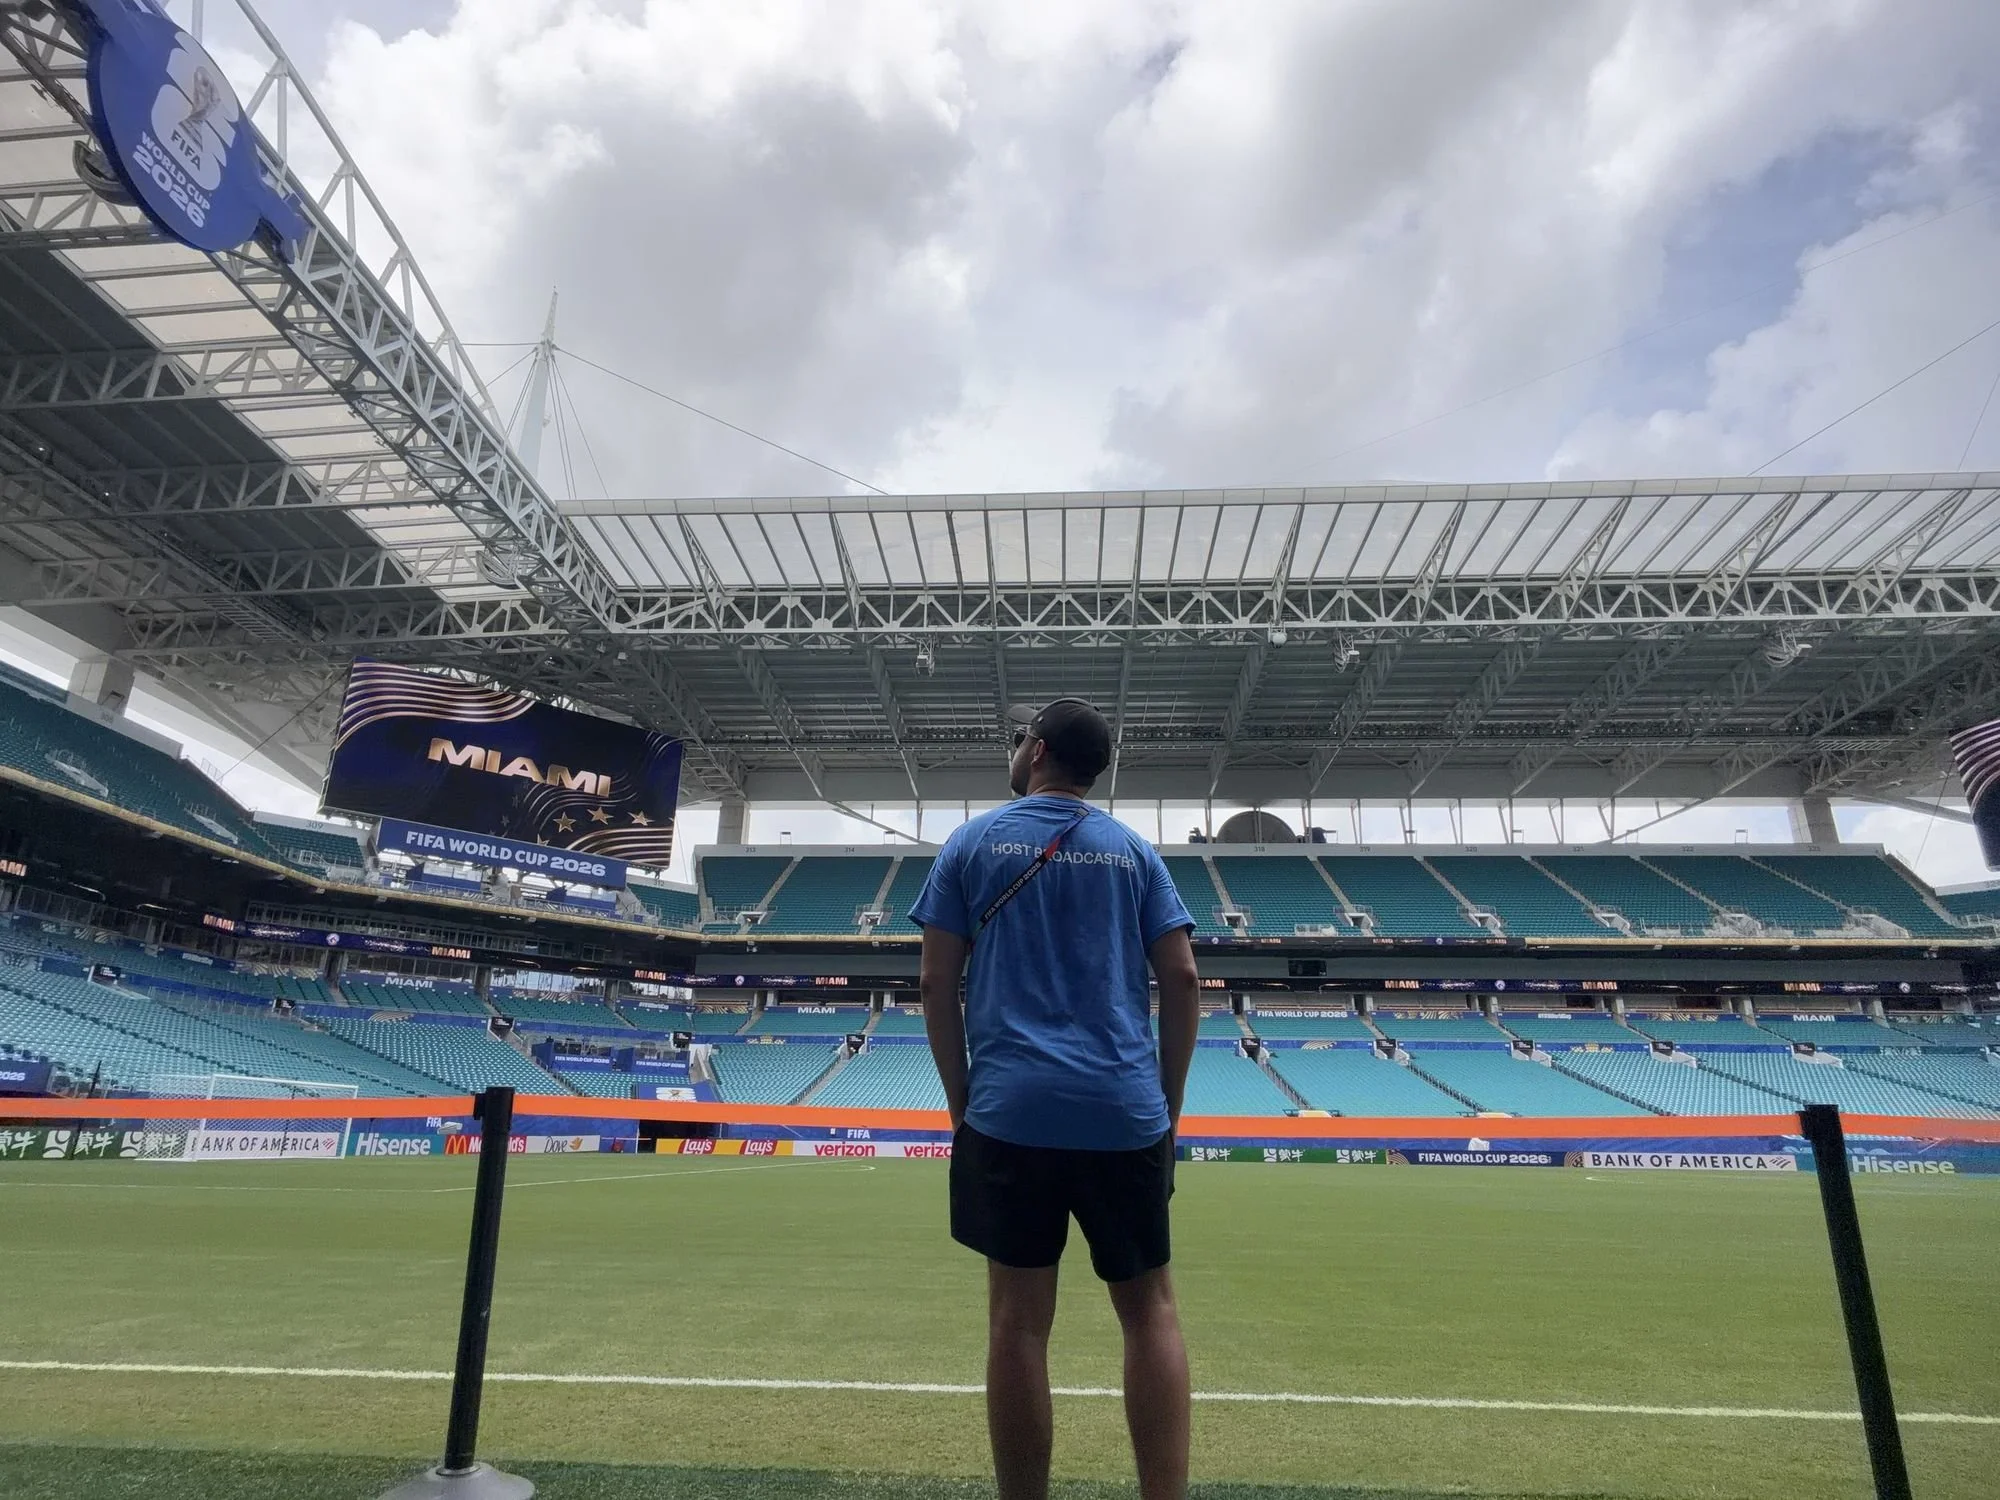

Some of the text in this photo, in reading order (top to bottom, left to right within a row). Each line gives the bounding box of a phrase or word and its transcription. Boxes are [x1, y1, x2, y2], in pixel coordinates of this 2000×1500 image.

[170, 129, 201, 171] FIFA
[142, 131, 210, 210] WORLD CUP
[132, 144, 205, 228] 2026
[427, 737, 611, 798] MIAMI
[406, 830, 606, 877] FIFA WORLD CUP 2026
[991, 843, 1031, 857] HOST
[0, 859, 27, 877] AMI
[984, 861, 1042, 920] FIFA WORLD CUP 2026
[203, 913, 235, 931] MIAMI
[431, 946, 471, 959] MIAMI
[385, 976, 433, 988] MIAMI
[634, 969, 666, 981] MIAMI
[815, 976, 848, 986] MIAMI
[1198, 979, 1225, 988] IAMI
[1384, 980, 1419, 989] MIAMI
[1581, 981, 1617, 990] MIAMI
[1783, 982, 1820, 992] MIAMI
[797, 1006, 836, 1014] MIAMI
[1273, 1010, 1302, 1018] WORLD
[1303, 1010, 1319, 1018] CUP
[1319, 1010, 1348, 1018] 2026
[1792, 1014, 1835, 1022] MIAMI
[426, 1116, 442, 1128] FIFA
[847, 1129, 871, 1139] FIFA
[239, 1136, 257, 1151] OF
[260, 1136, 320, 1152] AMERICA
[355, 1132, 431, 1156] Hisense
[544, 1135, 568, 1153] Dove
[684, 1138, 713, 1155] Lay's
[744, 1139, 774, 1155] Lay's
[814, 1142, 876, 1157] verizon
[903, 1142, 952, 1157] verizo
[1418, 1152, 1548, 1164] FIFA WORLD CUP 2026
[1591, 1153, 1768, 1169] BANK OF AMERICA
[1851, 1155, 1955, 1174] Hisense
